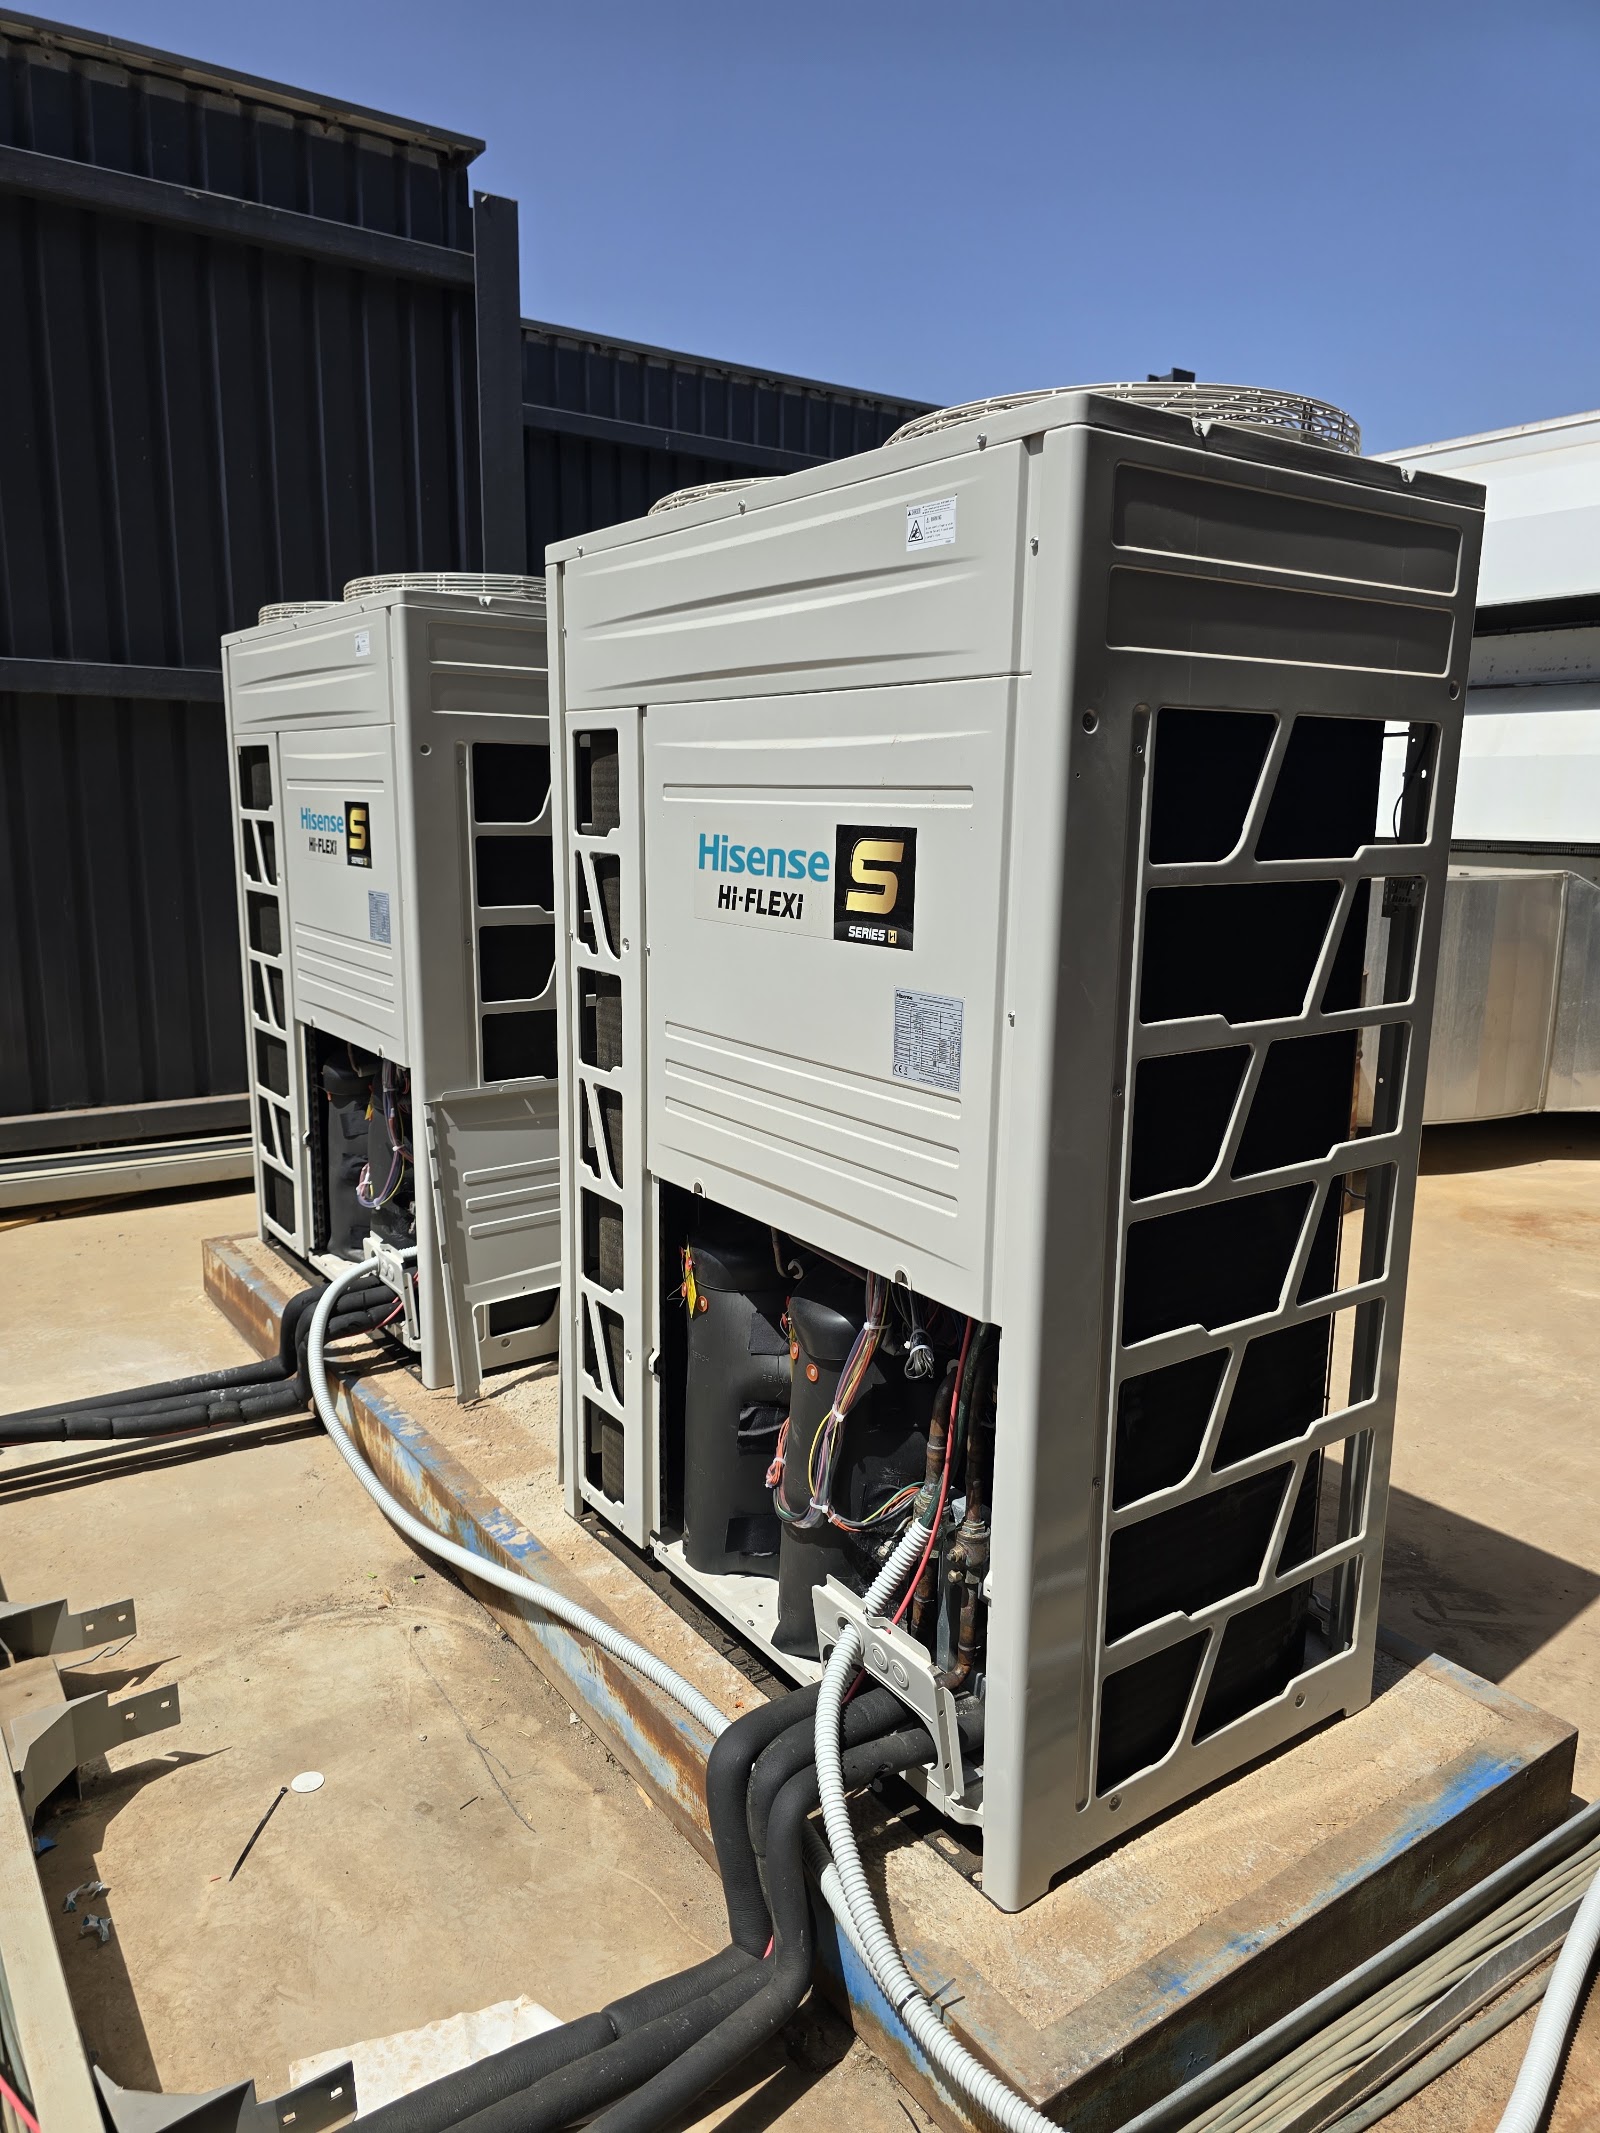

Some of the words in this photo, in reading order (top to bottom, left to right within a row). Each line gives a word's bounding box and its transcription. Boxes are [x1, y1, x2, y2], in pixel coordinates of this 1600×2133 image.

[300, 806, 344, 834] Hisense
[349, 807, 367, 850] S
[698, 833, 830, 882] Hisense
[845, 837, 905, 915] S
[717, 884, 804, 920] Hi-FLEXi
[847, 925, 886, 942] SERIES
